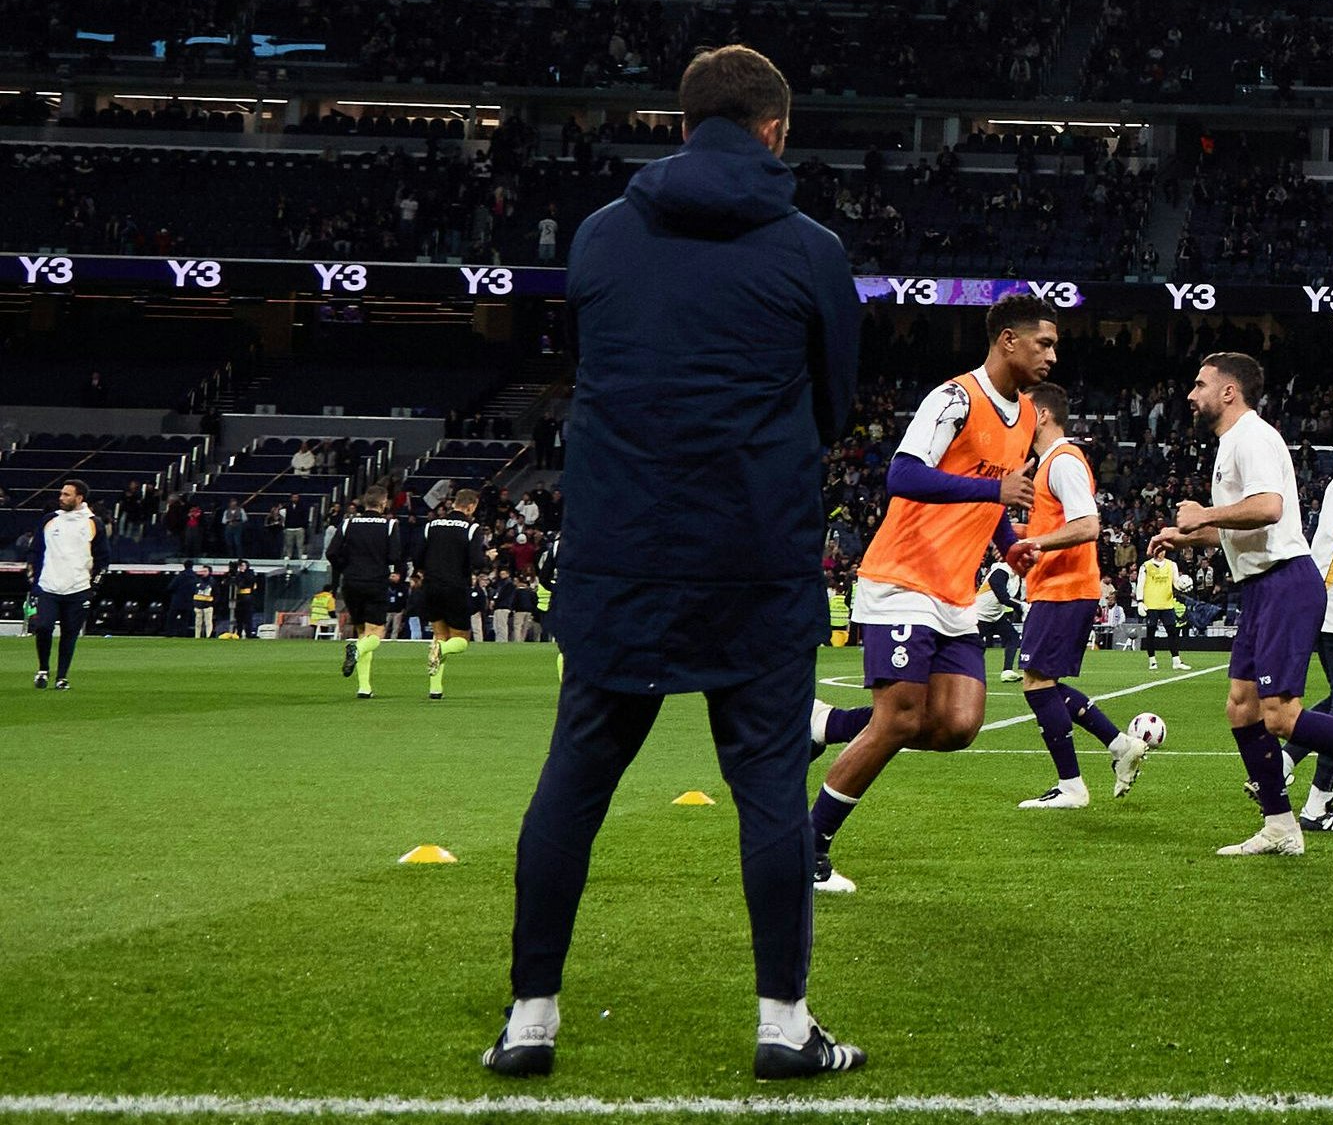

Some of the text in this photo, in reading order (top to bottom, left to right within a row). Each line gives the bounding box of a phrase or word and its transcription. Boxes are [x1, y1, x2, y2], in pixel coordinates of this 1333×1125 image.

[20, 257, 72, 283] Y-3
[168, 261, 220, 287] Y-3
[315, 264, 366, 290] Y-3
[461, 268, 512, 294] Y-3
[888, 279, 937, 304] Y-3
[1028, 282, 1076, 307] Y-3
[1165, 284, 1215, 309] Y-3
